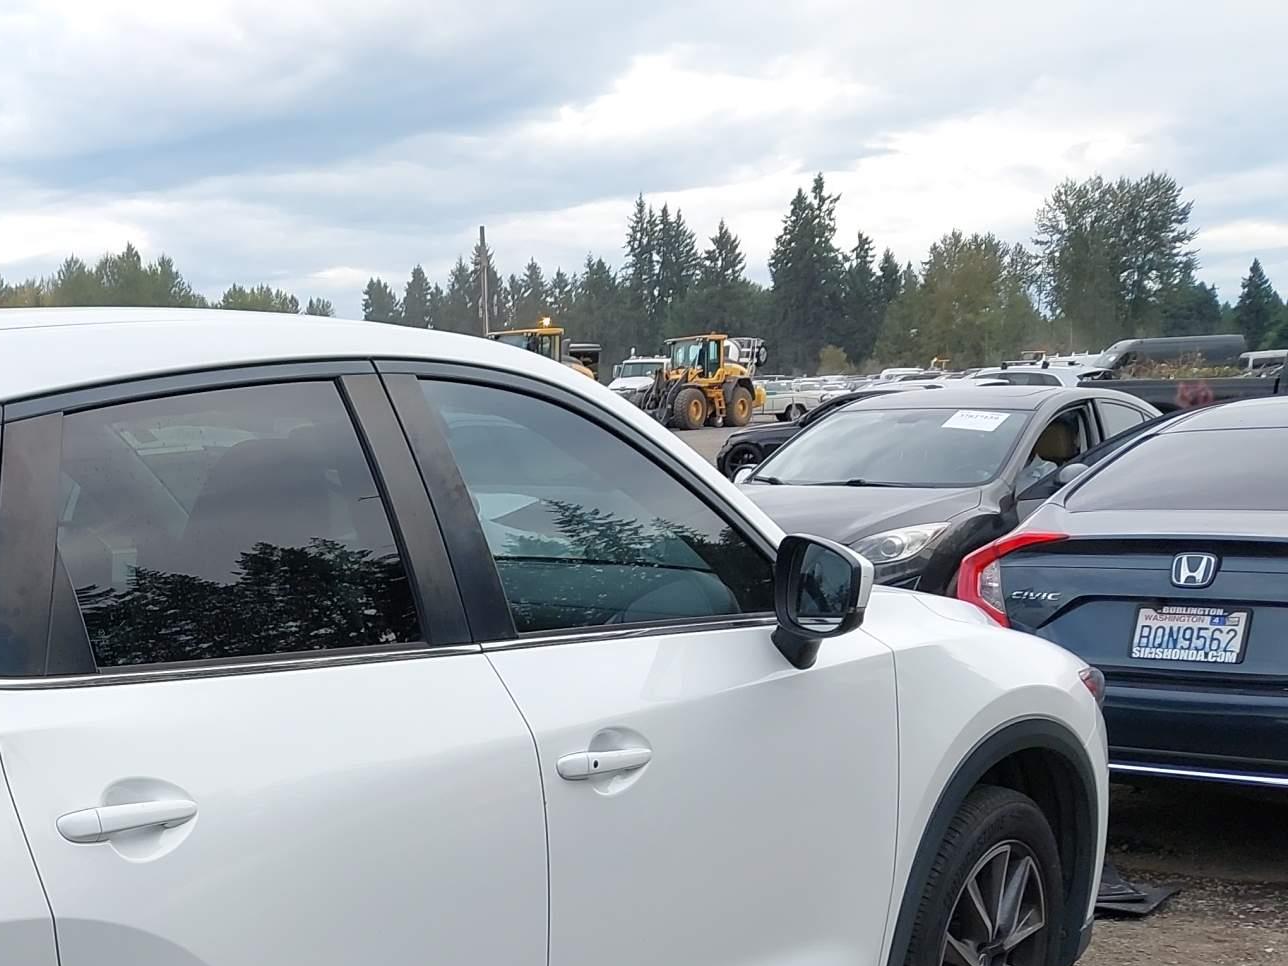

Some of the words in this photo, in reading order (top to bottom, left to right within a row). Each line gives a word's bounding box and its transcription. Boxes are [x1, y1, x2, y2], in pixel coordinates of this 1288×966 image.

[1011, 590, 1062, 601] CIVIC
[1144, 614, 1206, 624] WASHINGTON
[1131, 646, 1238, 664] SIMSHONDA.COM
